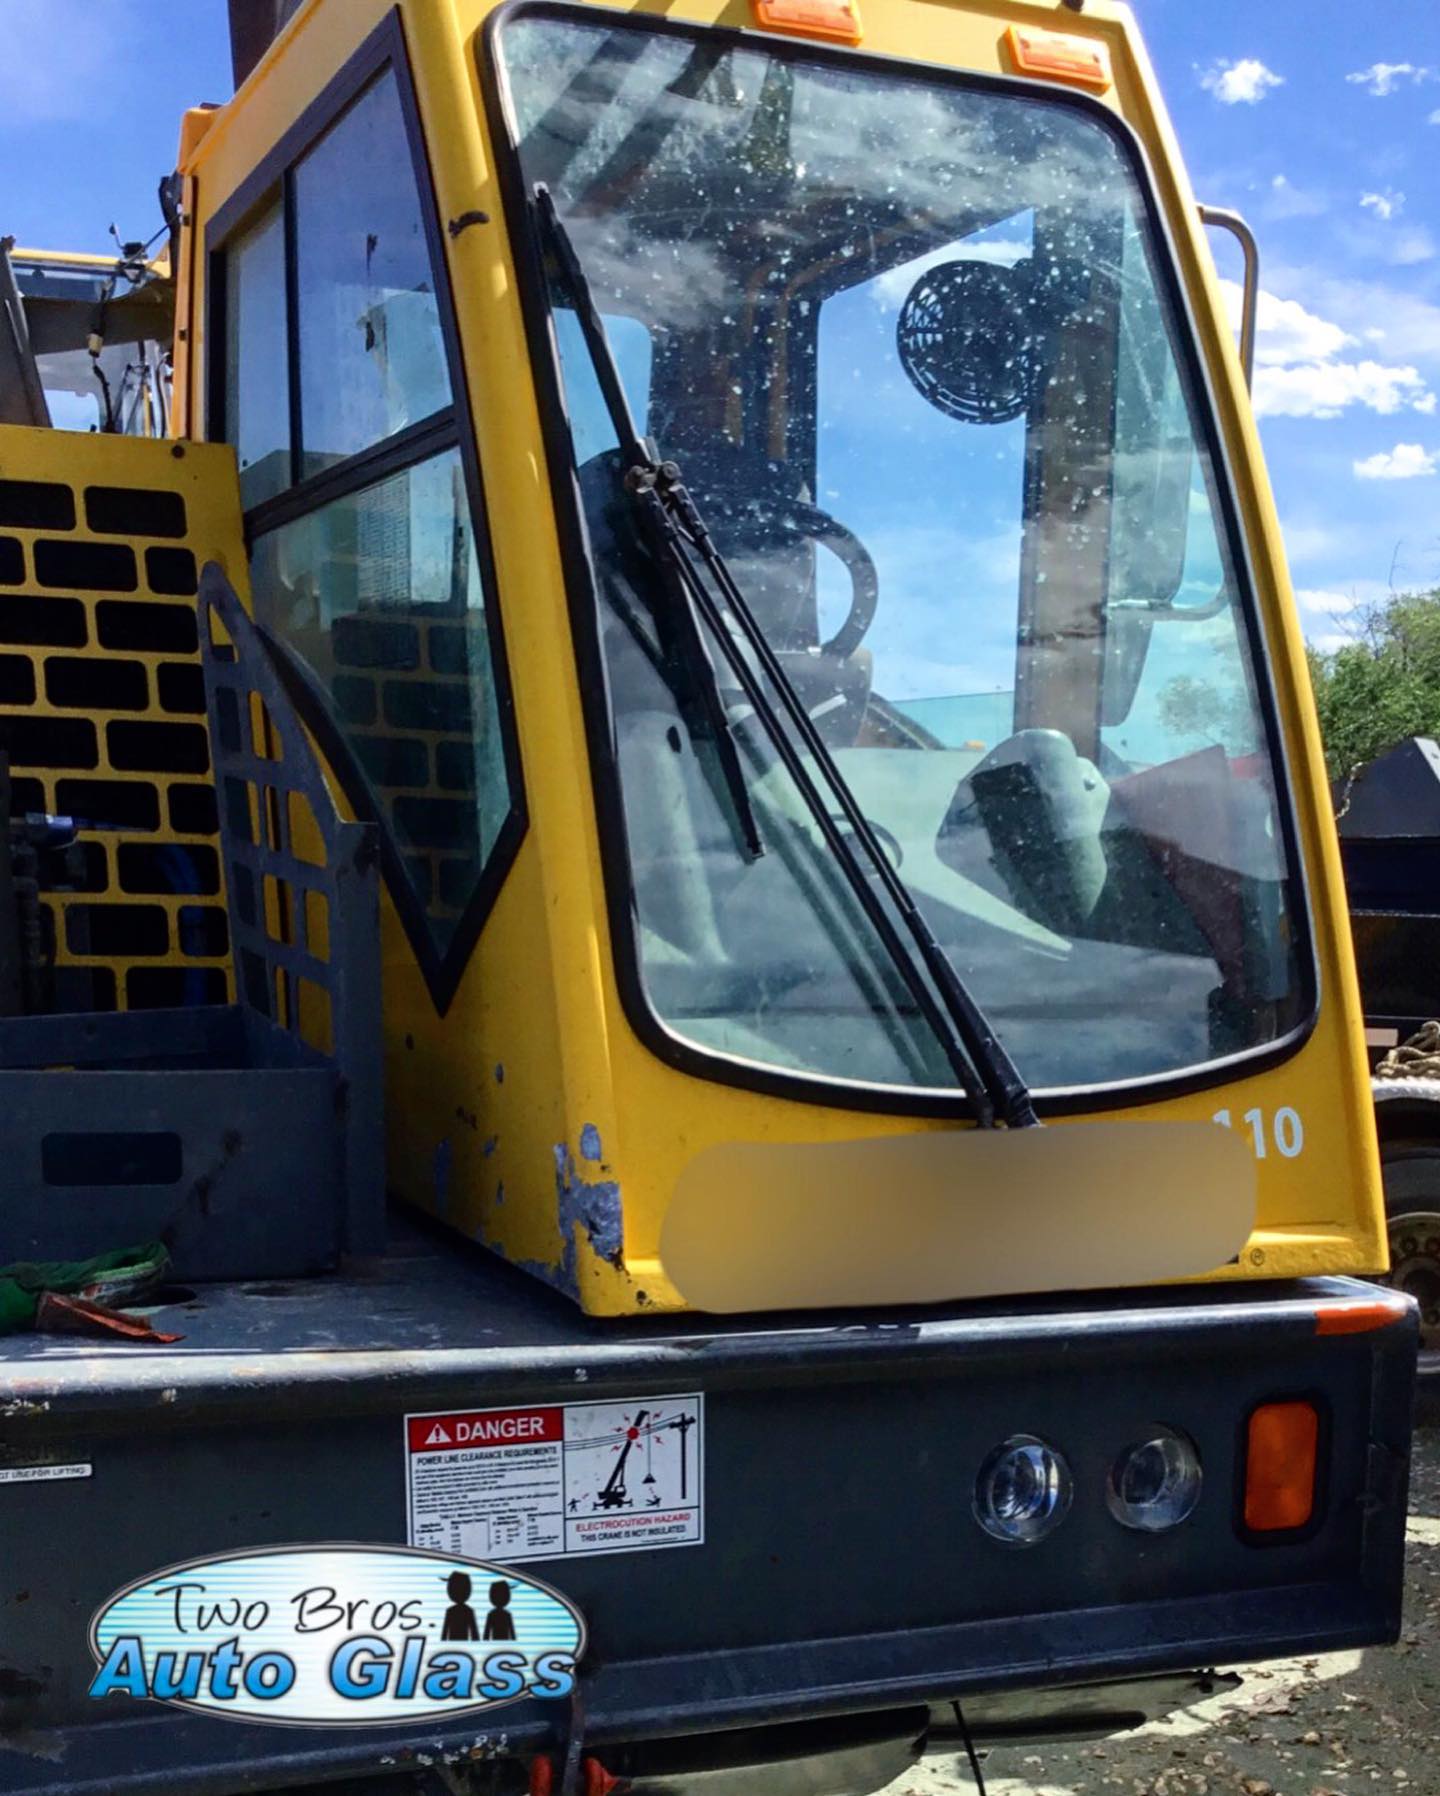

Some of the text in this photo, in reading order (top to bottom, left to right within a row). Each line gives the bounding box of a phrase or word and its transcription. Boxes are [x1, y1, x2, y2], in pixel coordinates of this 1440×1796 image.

[456, 1416, 545, 1442] DANGER
[417, 1446, 557, 1465] POWER LINE CLEARANCE REQUIREMENTS
[575, 1513, 691, 1532] ELECTROCUTION HAZARD
[581, 1524, 687, 1541] THIS CRANE IS NOT INSULATED
